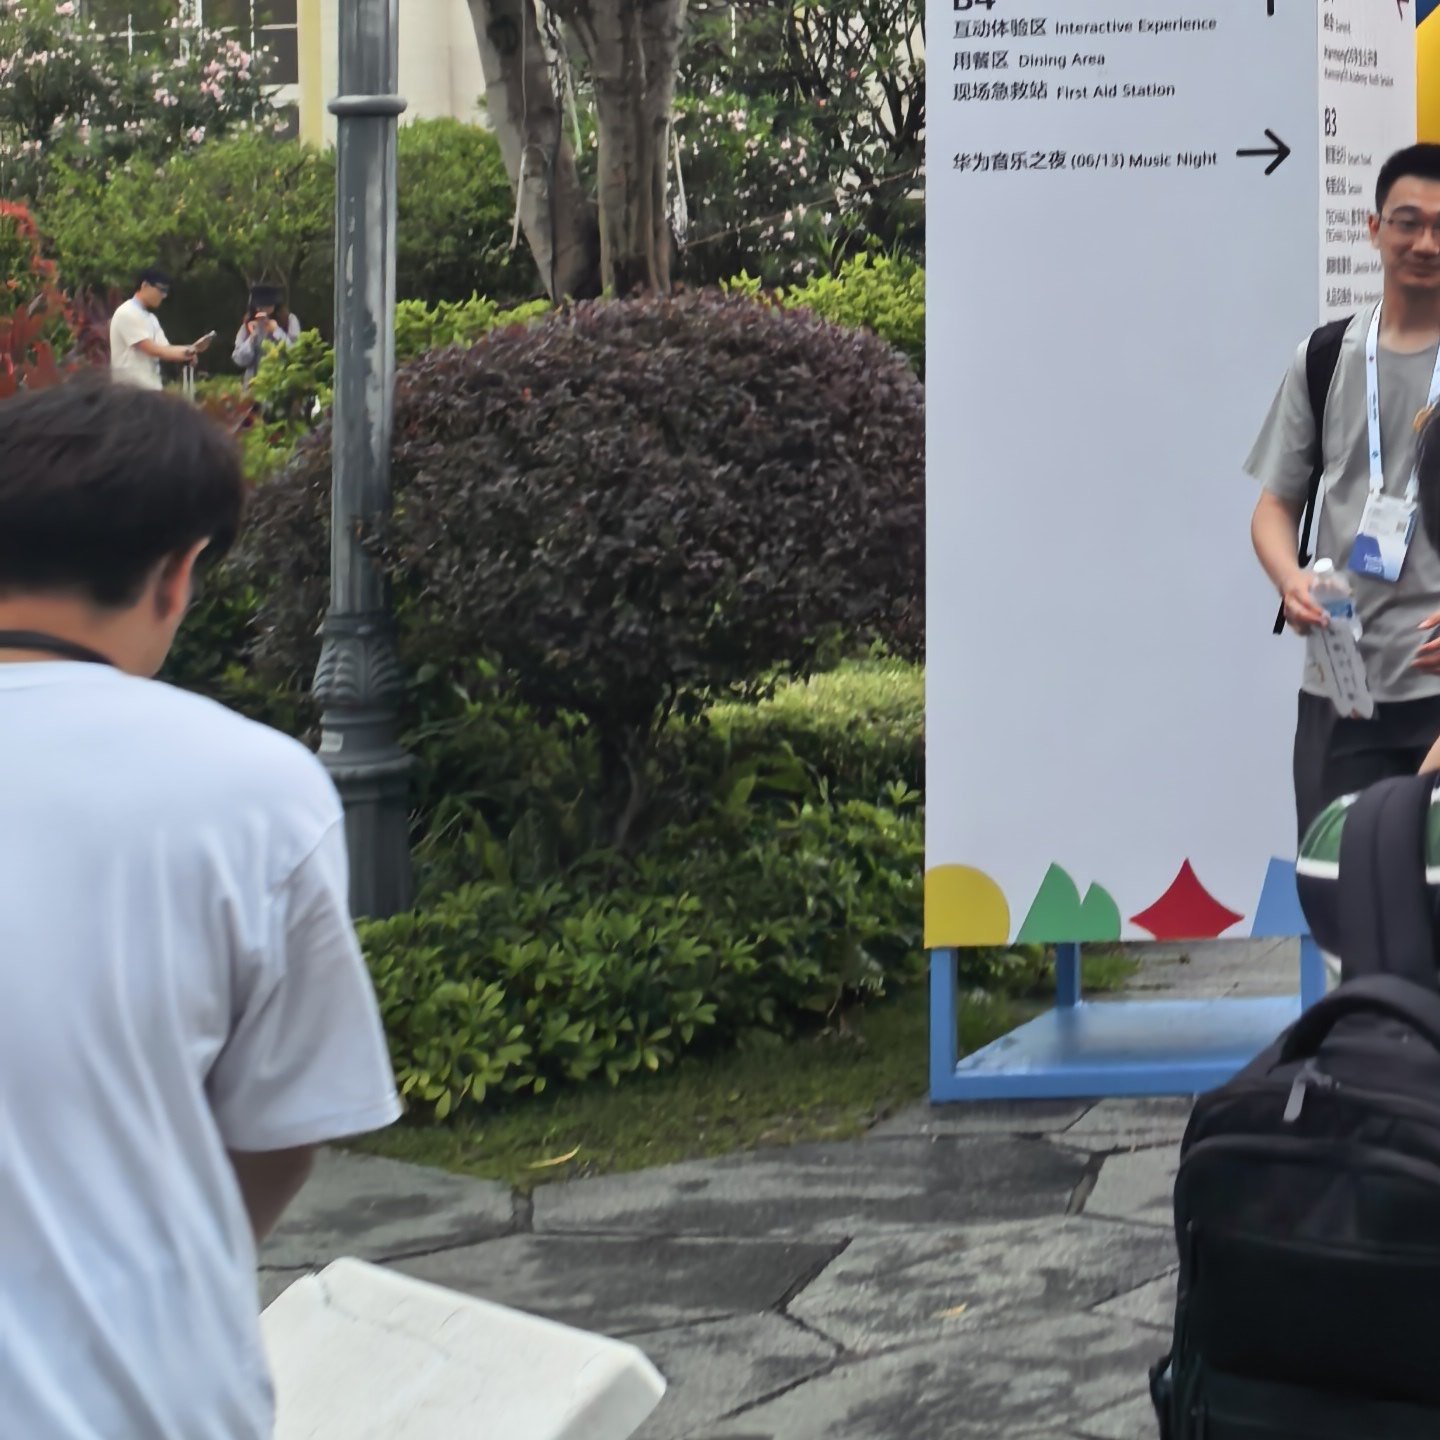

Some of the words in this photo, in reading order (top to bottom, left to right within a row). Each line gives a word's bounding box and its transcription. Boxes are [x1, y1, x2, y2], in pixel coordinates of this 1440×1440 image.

[952, 17, 1048, 40] 互动体验区
[1055, 17, 1133, 35] Interactive
[1138, 16, 1218, 36] Experience
[952, 49, 1009, 71] 用餐区
[1018, 52, 1067, 70] Dining
[1071, 52, 1105, 67] Area
[952, 78, 1048, 102] 现场急救站
[1056, 82, 1088, 101] First
[1092, 82, 1118, 100] Aid
[1122, 81, 1176, 98] Station
[1324, 105, 1337, 137] B3
[952, 150, 1067, 173] 华为音乐之夜
[1071, 151, 1126, 170] (06/13)
[1128, 151, 1172, 169] Music
[1176, 150, 1218, 170] Night
